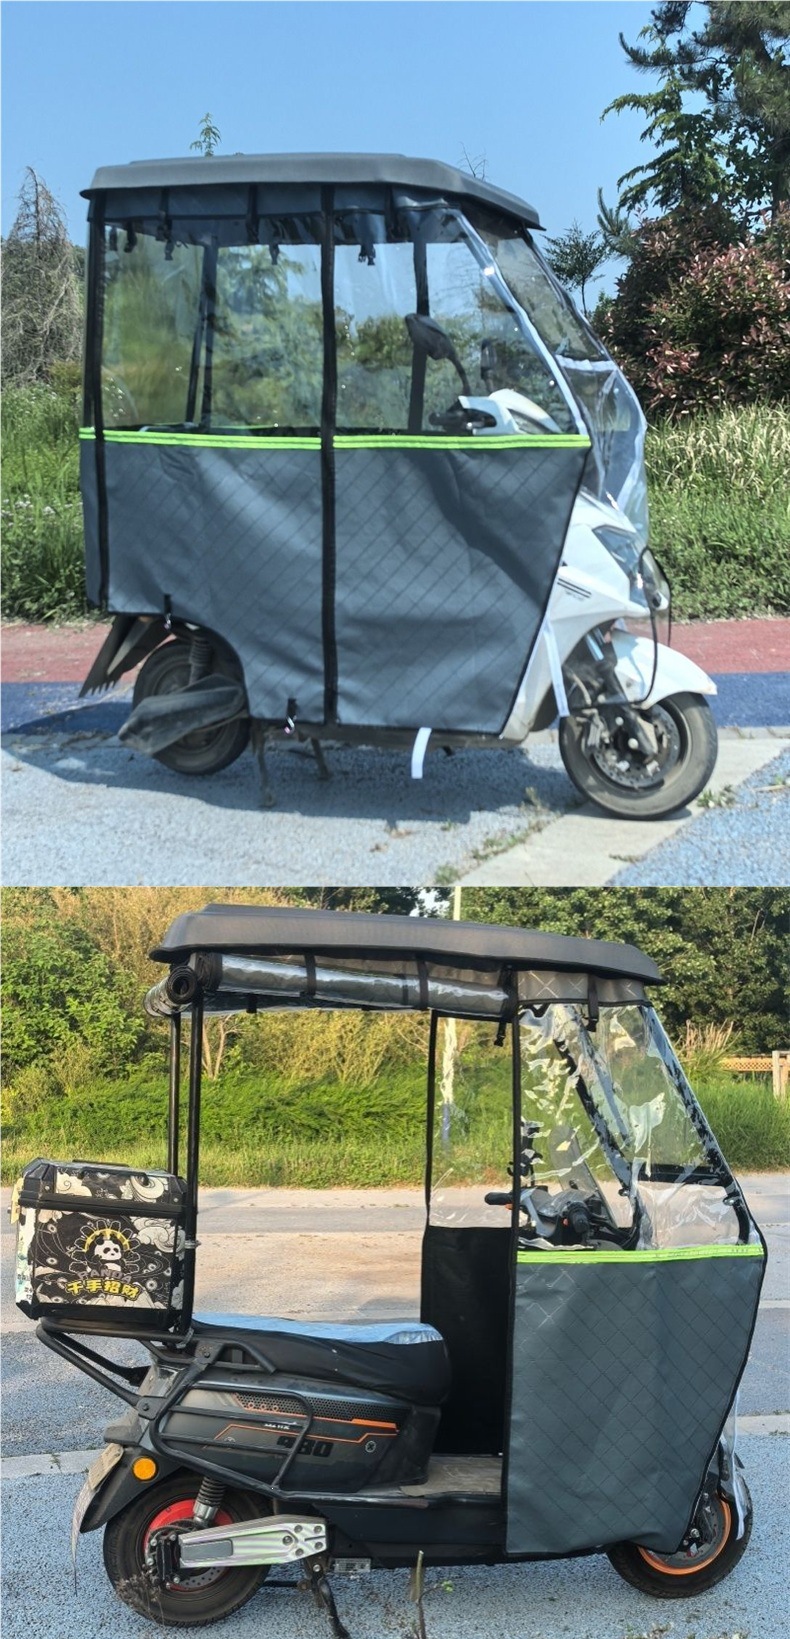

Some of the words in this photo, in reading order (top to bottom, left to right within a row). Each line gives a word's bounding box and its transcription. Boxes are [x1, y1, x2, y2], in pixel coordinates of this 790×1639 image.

[78, 1268, 132, 1284] PANDA
[66, 1279, 140, 1300] 千手招财
